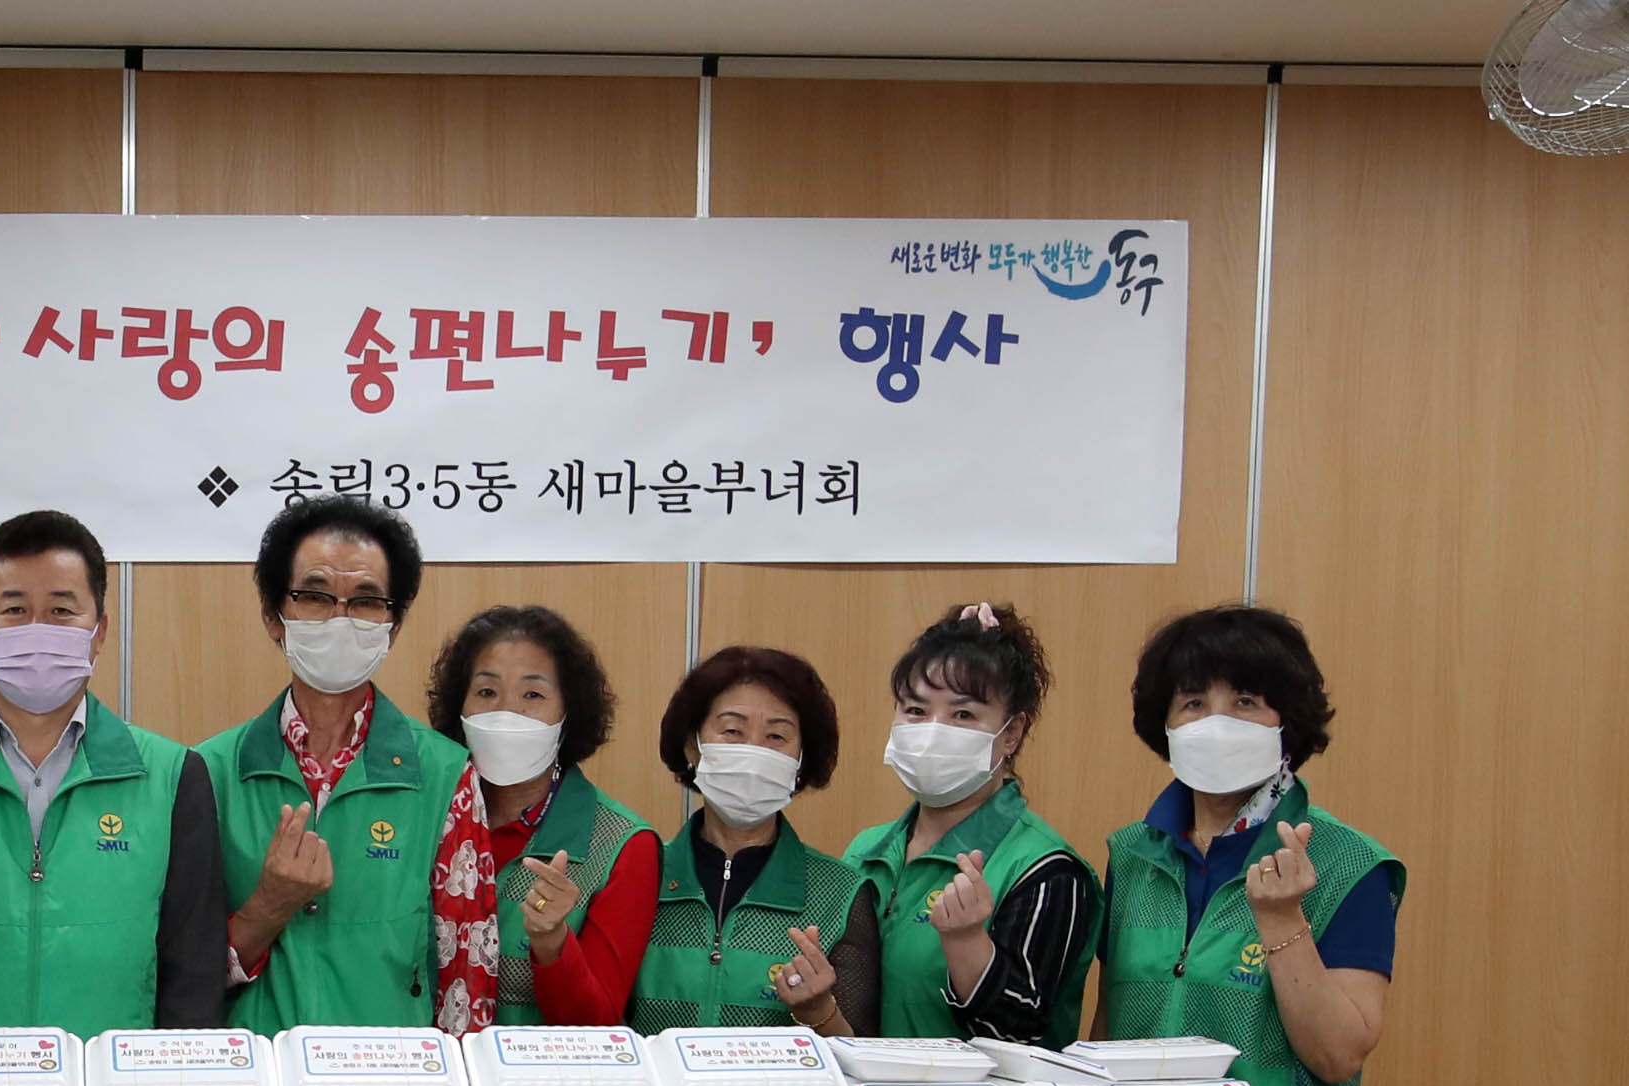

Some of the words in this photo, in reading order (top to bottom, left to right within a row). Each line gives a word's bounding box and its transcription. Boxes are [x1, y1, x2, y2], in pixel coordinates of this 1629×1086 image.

[890, 241, 937, 274] 새로운
[940, 240, 982, 274] 변화
[988, 242, 1035, 281] 모두가
[1041, 239, 1093, 281] 행복한
[839, 307, 1019, 403] 행사
[538, 458, 861, 516] 새마을부녀회
[96, 840, 130, 852] SMU
[366, 848, 399, 859] SMU
